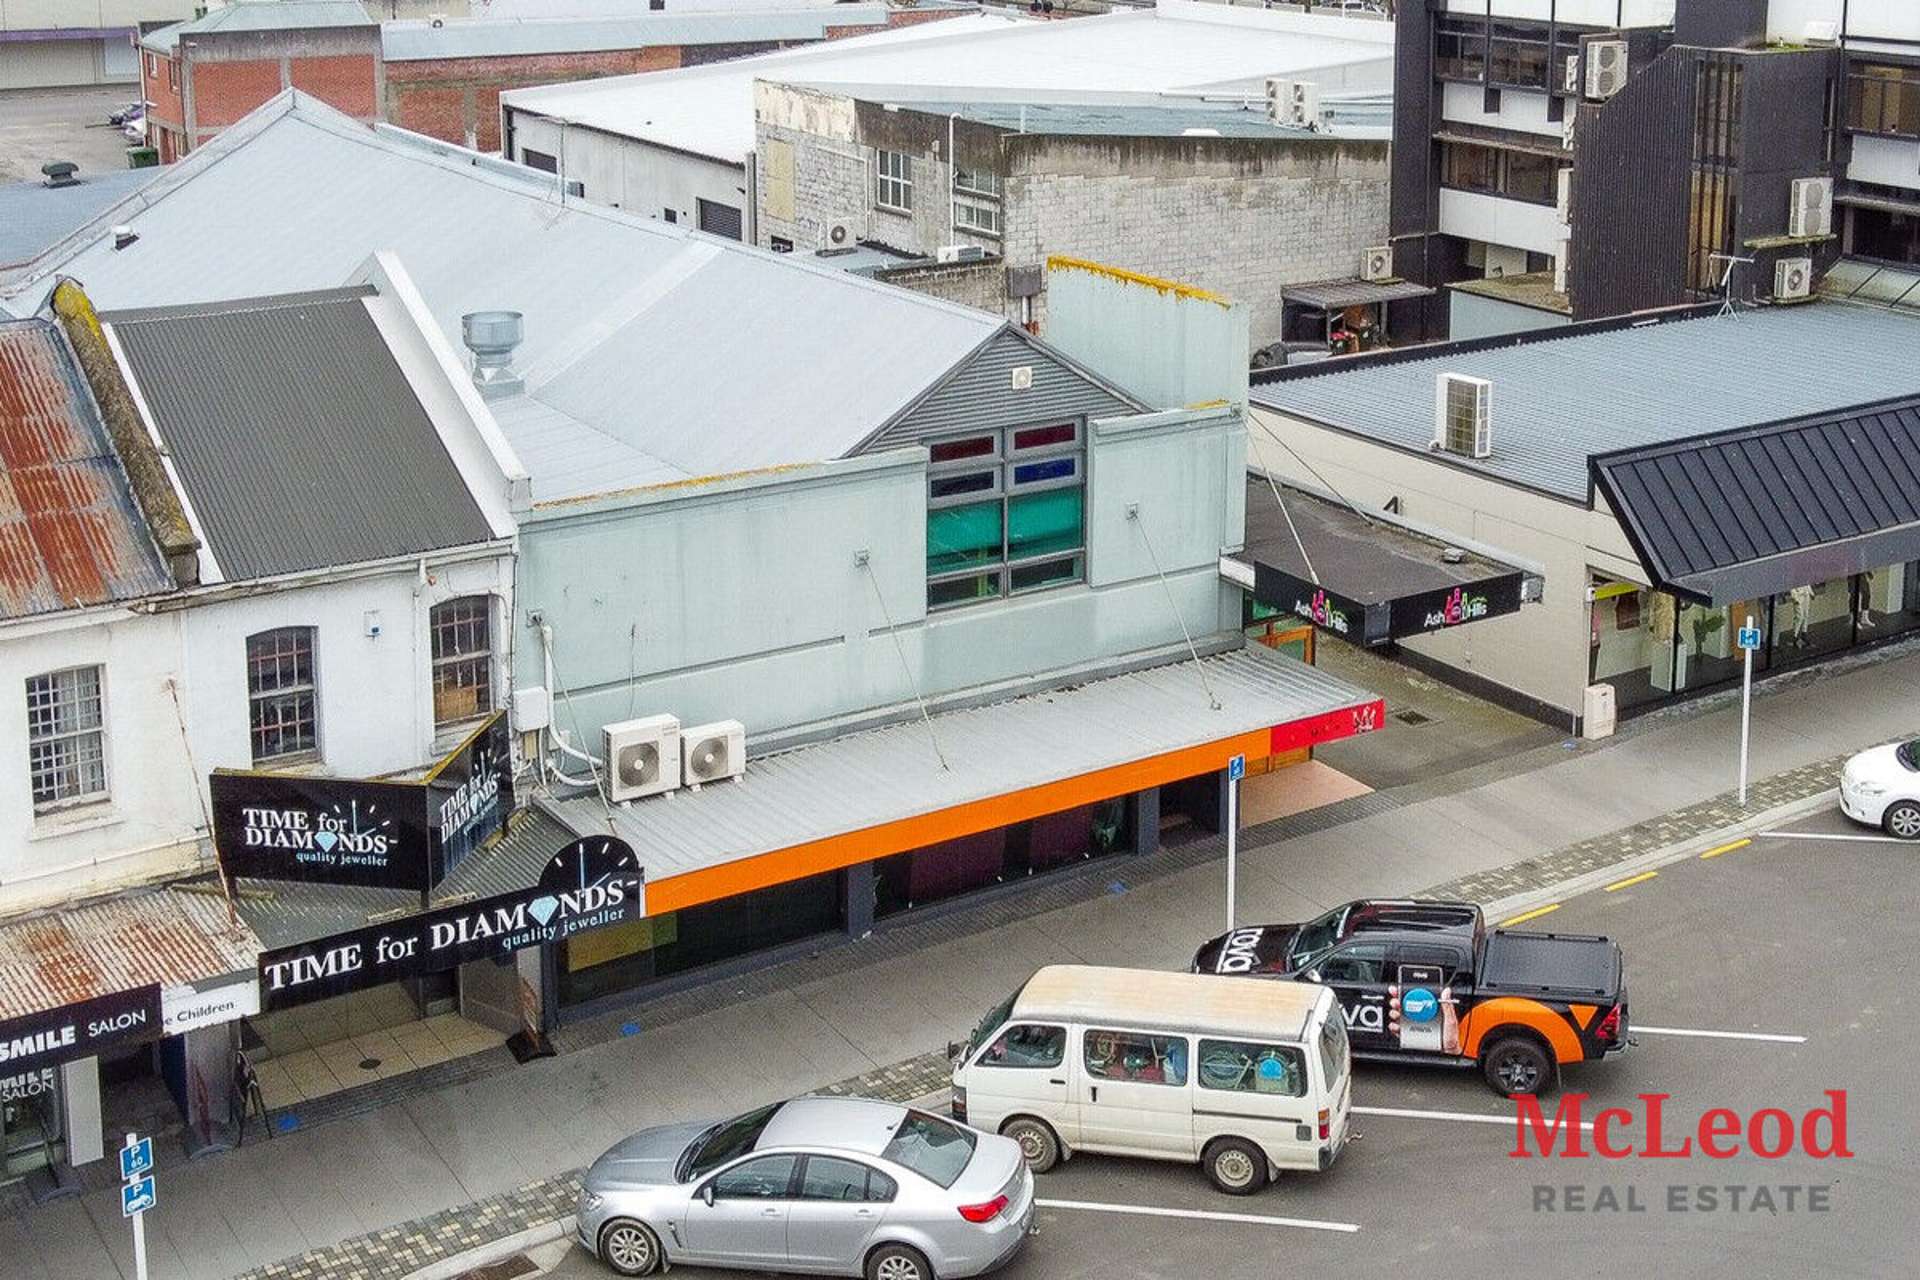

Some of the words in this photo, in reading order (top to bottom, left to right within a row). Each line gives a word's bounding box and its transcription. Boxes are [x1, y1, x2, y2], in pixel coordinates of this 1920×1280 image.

[1424, 611, 1446, 628] Ash
[440, 783, 468, 822] TIME
[242, 808, 310, 830] TIME
[317, 813, 347, 833] for
[296, 852, 337, 865] quality
[340, 853, 388, 866] jeweller
[502, 923, 557, 951] quality
[562, 907, 625, 935] jeweller
[265, 944, 362, 990] TIME
[376, 933, 419, 964] for
[88, 1008, 147, 1038] SALON
[177, 1001, 236, 1022] Children
[2, 1079, 55, 1103] SALON
[131, 1144, 141, 1159] P
